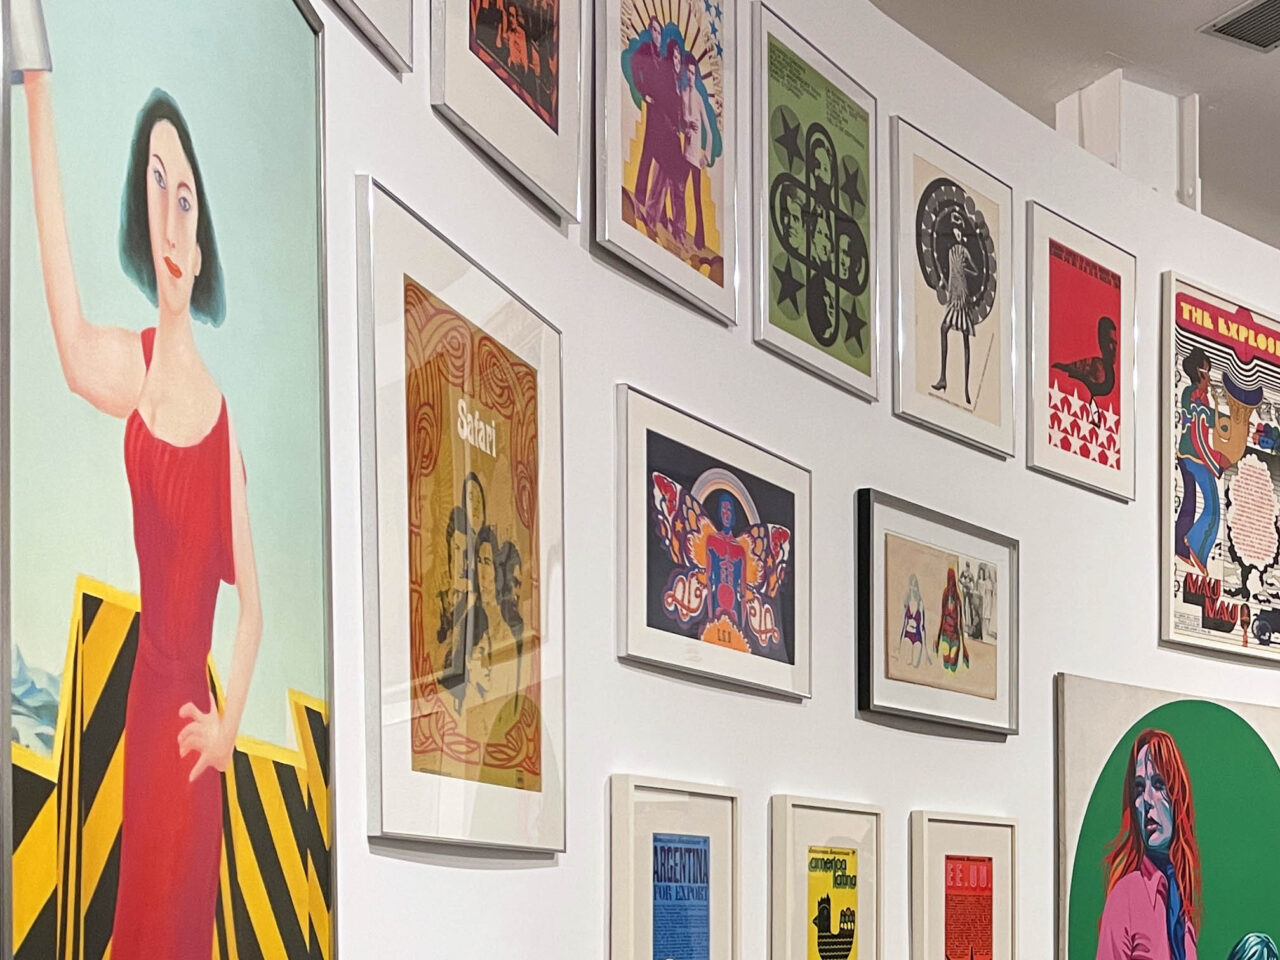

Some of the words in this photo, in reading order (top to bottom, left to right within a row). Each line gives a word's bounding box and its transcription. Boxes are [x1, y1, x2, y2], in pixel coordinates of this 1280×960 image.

[1180, 301, 1214, 330] THE
[457, 398, 497, 458] Safari
[1186, 572, 1221, 599] MAU
[1204, 597, 1238, 623] MAU
[653, 845, 709, 884] ARGENTINA
[653, 884, 672, 900] FOR
[675, 885, 708, 901] EXPORT
